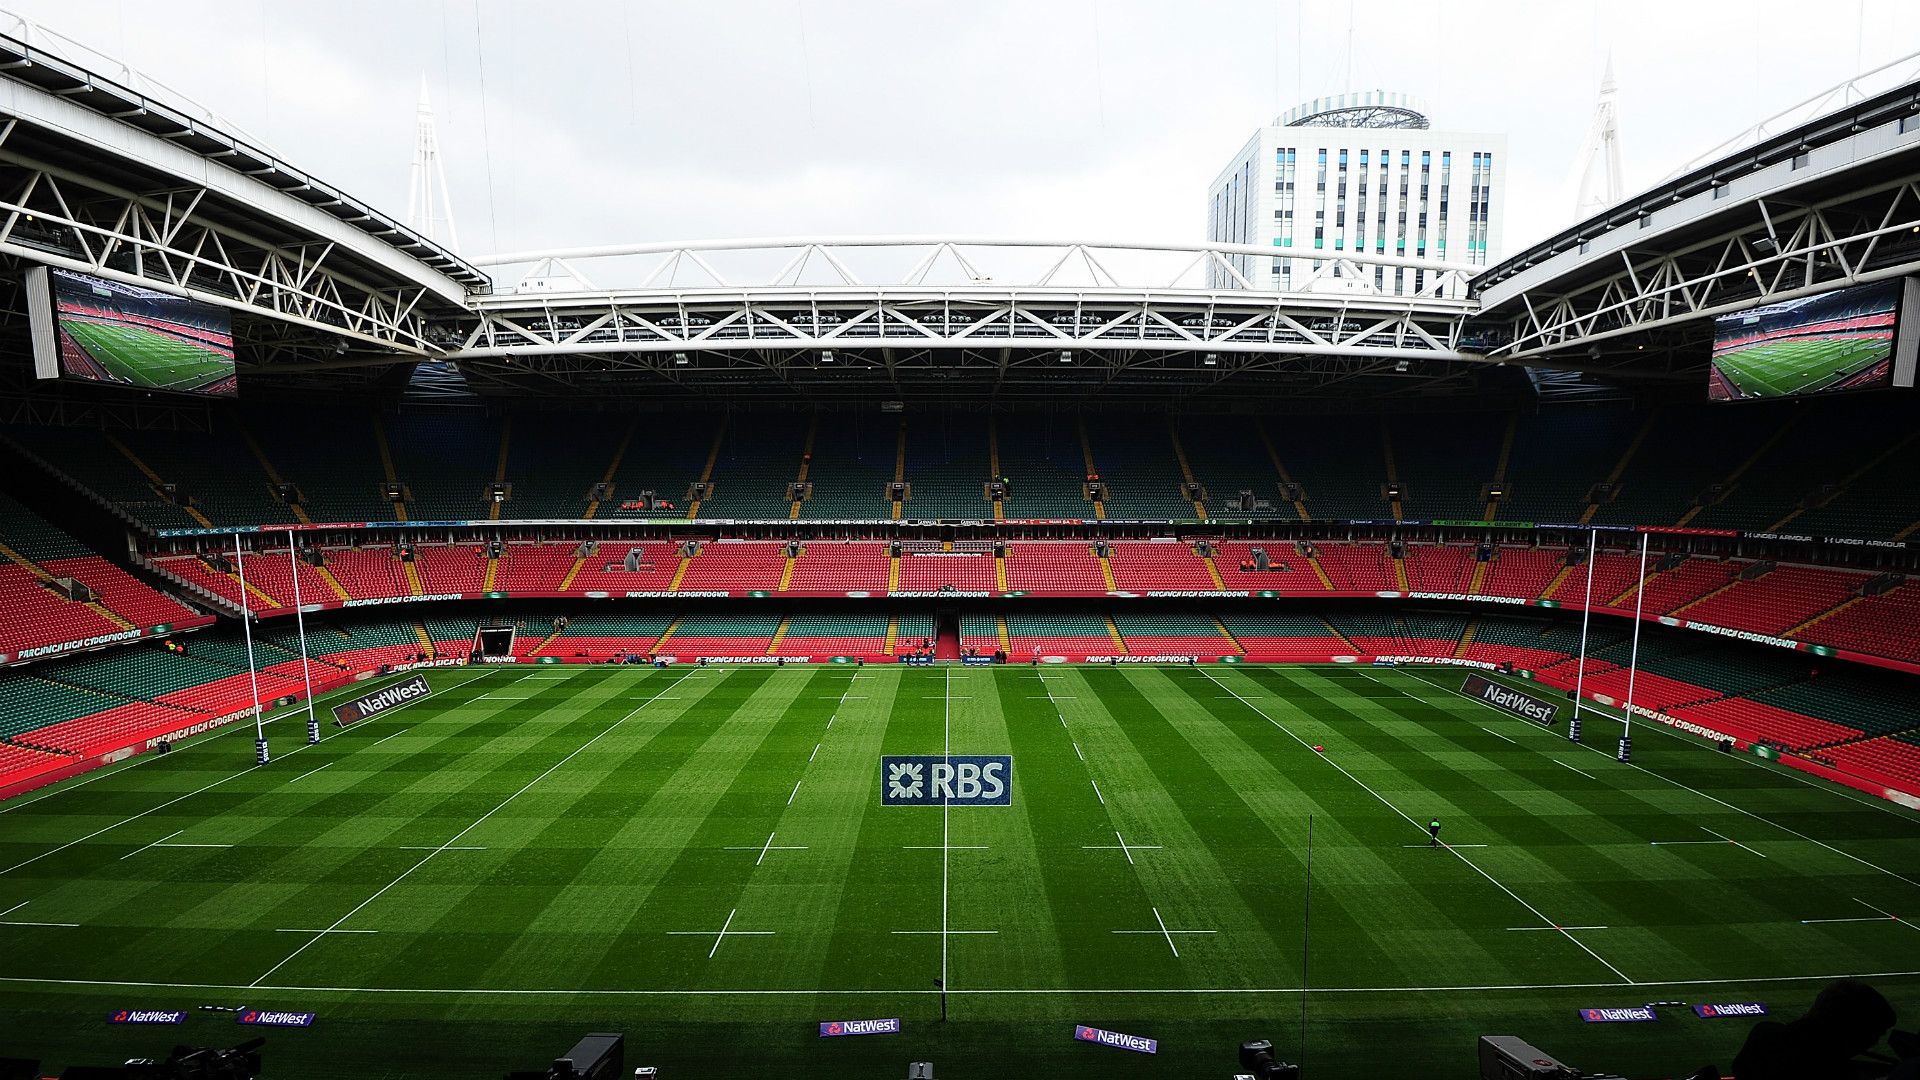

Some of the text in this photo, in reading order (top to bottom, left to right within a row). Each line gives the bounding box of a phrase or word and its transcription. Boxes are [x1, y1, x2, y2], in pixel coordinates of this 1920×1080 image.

[1779, 534, 1812, 542] ARMOUR
[1866, 540, 1906, 548] ARMOUR
[64, 639, 82, 650] EICH
[357, 680, 426, 715] NatWest
[1484, 685, 1551, 721] NatWest
[1658, 714, 1674, 725] EICH
[190, 722, 207, 734] EICH
[931, 762, 1004, 798] RBS
[1600, 1009, 1652, 1020] NatWest
[1713, 1004, 1764, 1015] NatWest
[128, 1011, 178, 1022] NatWest
[257, 1012, 307, 1024] NatWest
[844, 1019, 895, 1033] NatWest
[1098, 1030, 1150, 1050] NatWest
